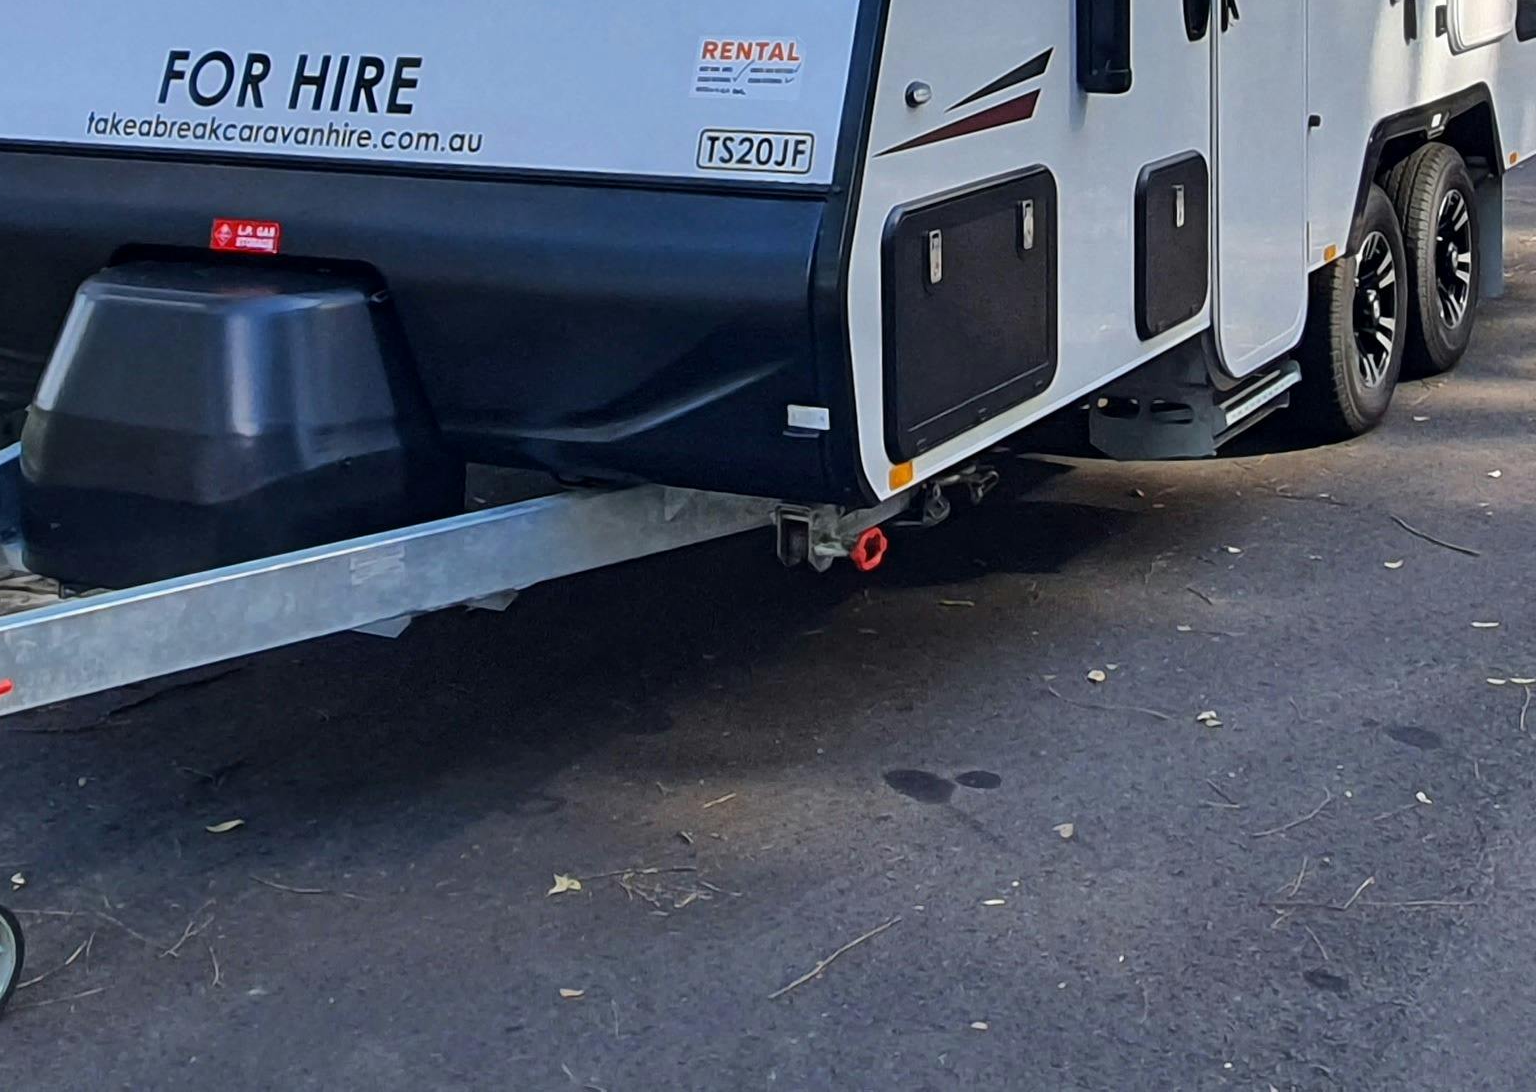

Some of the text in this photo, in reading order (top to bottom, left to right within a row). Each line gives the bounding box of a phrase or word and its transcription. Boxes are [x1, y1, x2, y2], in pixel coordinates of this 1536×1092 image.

[701, 40, 800, 61] RENTAL
[158, 50, 423, 114] FOR HIRE
[86, 111, 483, 153] takeabreakcaravanhire.com.au
[707, 135, 807, 167] TS20JF
